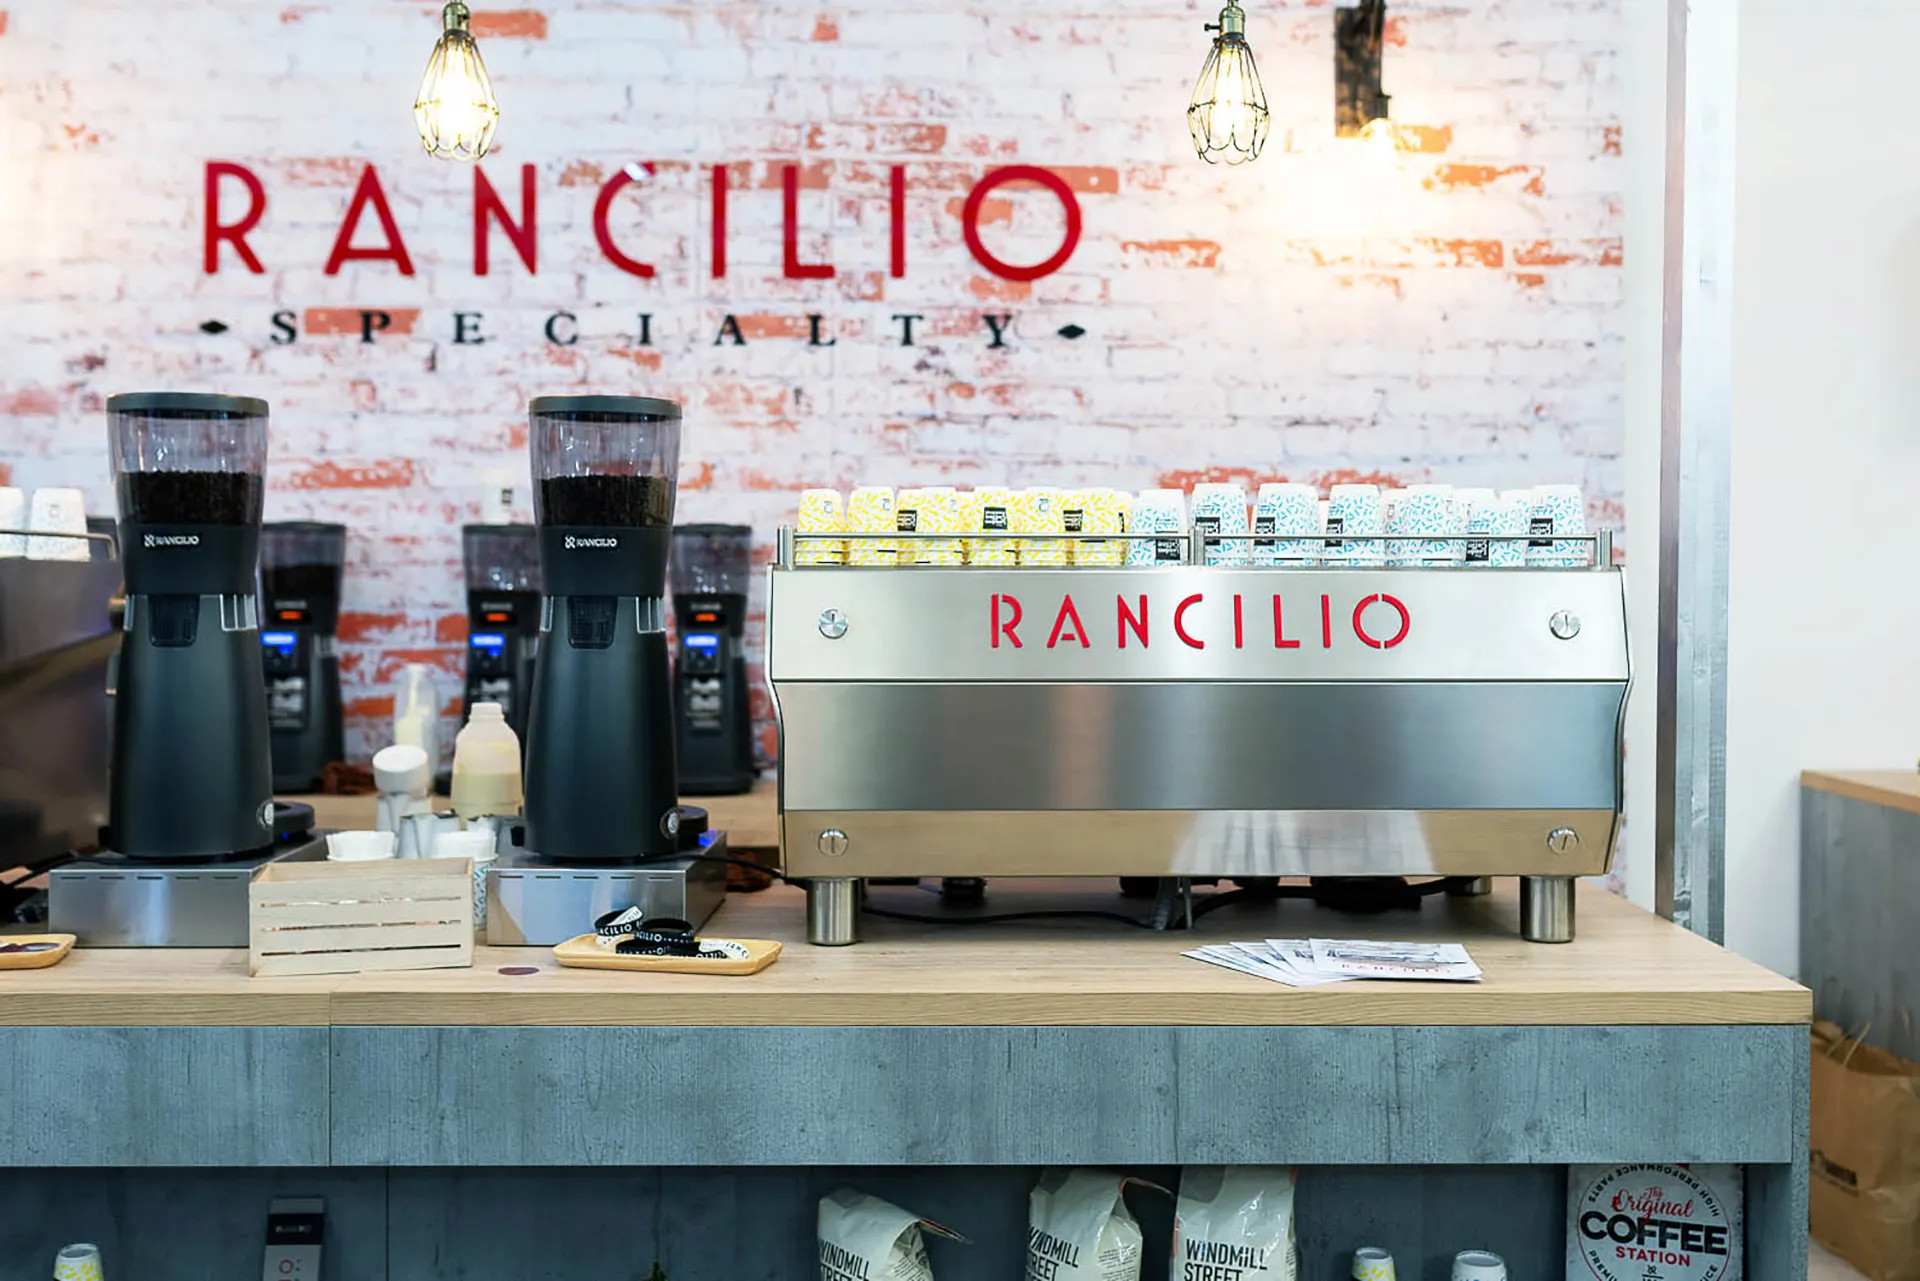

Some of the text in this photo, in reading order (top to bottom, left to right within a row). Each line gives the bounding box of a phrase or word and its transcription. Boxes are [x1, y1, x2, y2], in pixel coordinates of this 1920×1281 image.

[204, 162, 1083, 283] RANCILIO
[271, 311, 1015, 348] SPECIALTY
[991, 593, 1411, 649] RANCILIO
[1588, 1163, 1720, 1217] HIGH PERFORMANCE PARTS
[1611, 1189, 1696, 1226] Original
[1580, 1210, 1727, 1256] COFFEE
[1184, 1262, 1243, 1281] STREET
[1186, 1238, 1268, 1270] WINDMILL
[1615, 1246, 1690, 1267] STATION
